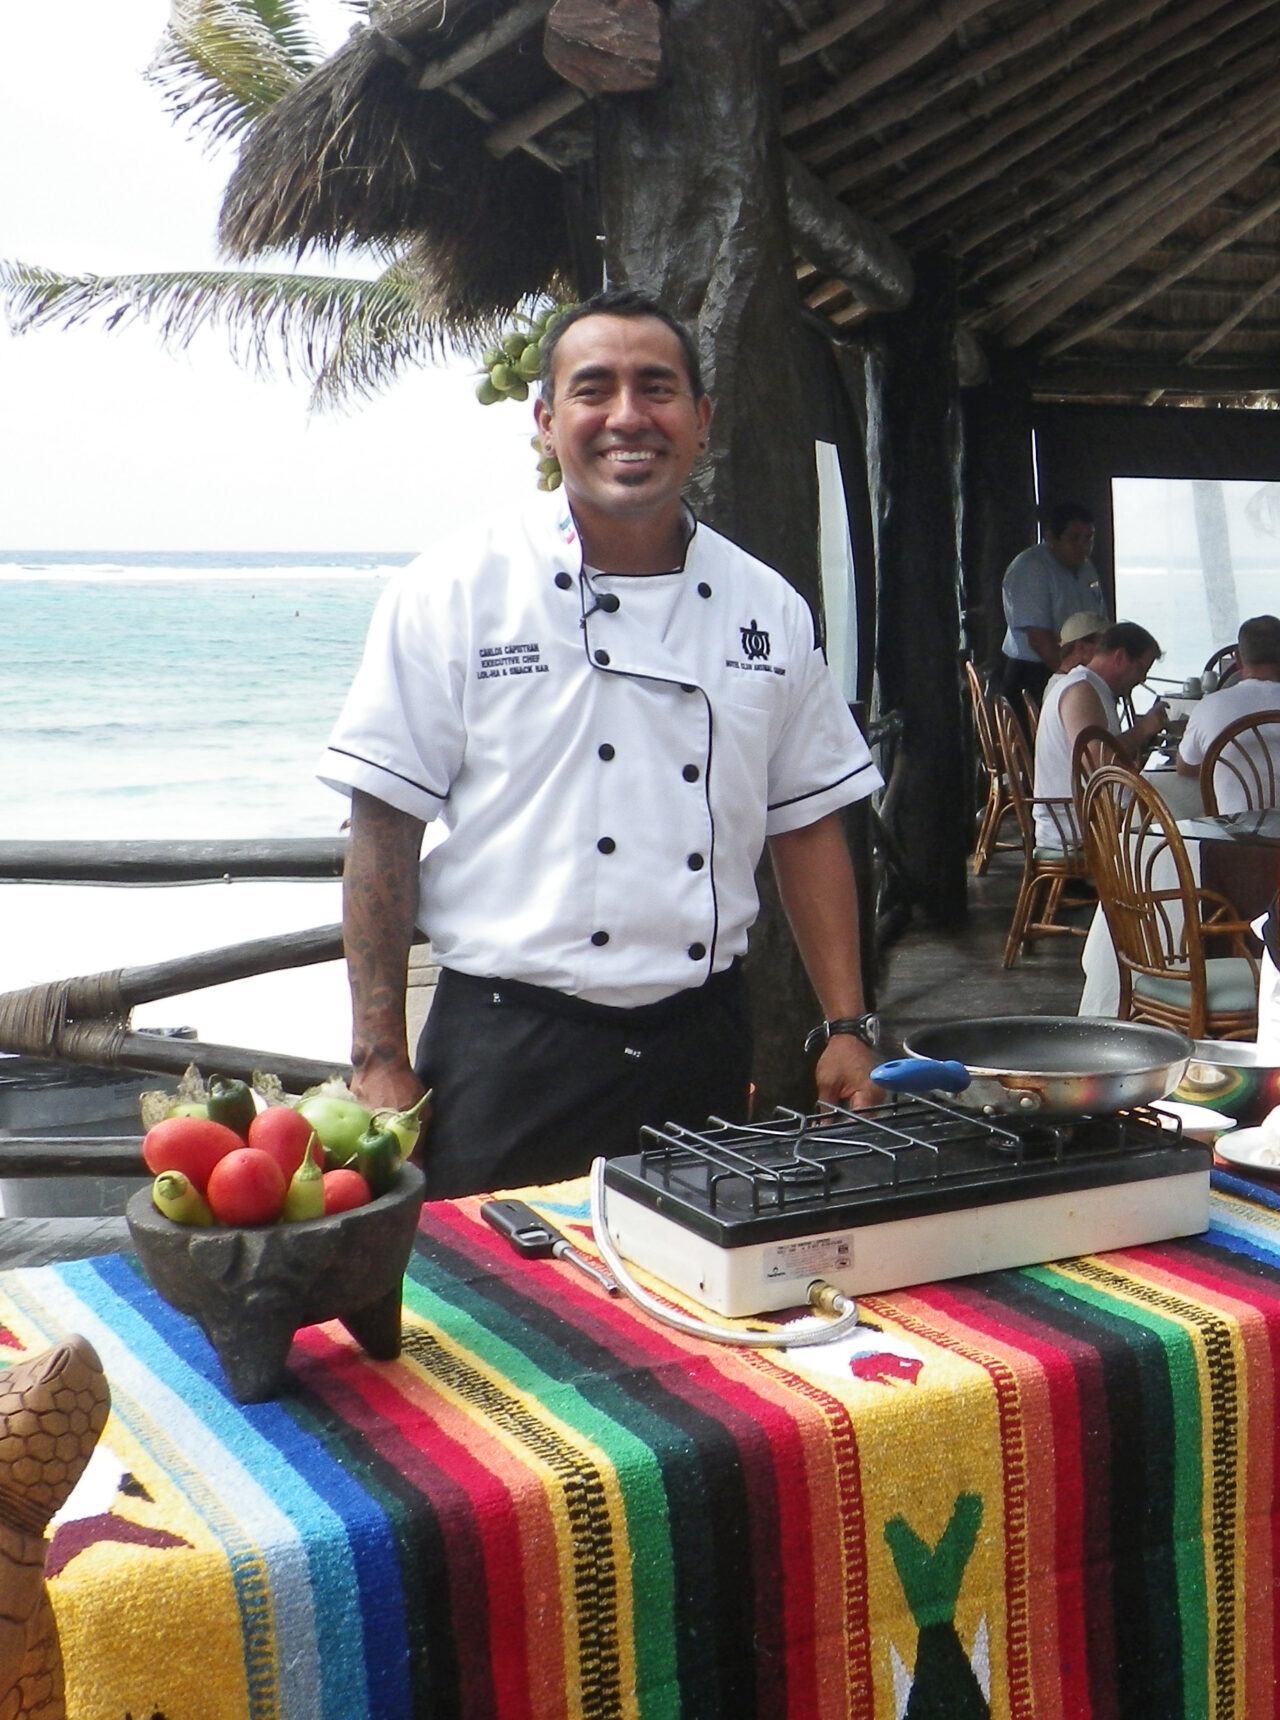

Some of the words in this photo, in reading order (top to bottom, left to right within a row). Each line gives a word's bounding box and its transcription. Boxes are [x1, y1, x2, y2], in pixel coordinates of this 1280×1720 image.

[482, 657, 520, 668] EXECUTIVE
[522, 655, 540, 663] CHEF
[535, 664, 550, 673] BAR
